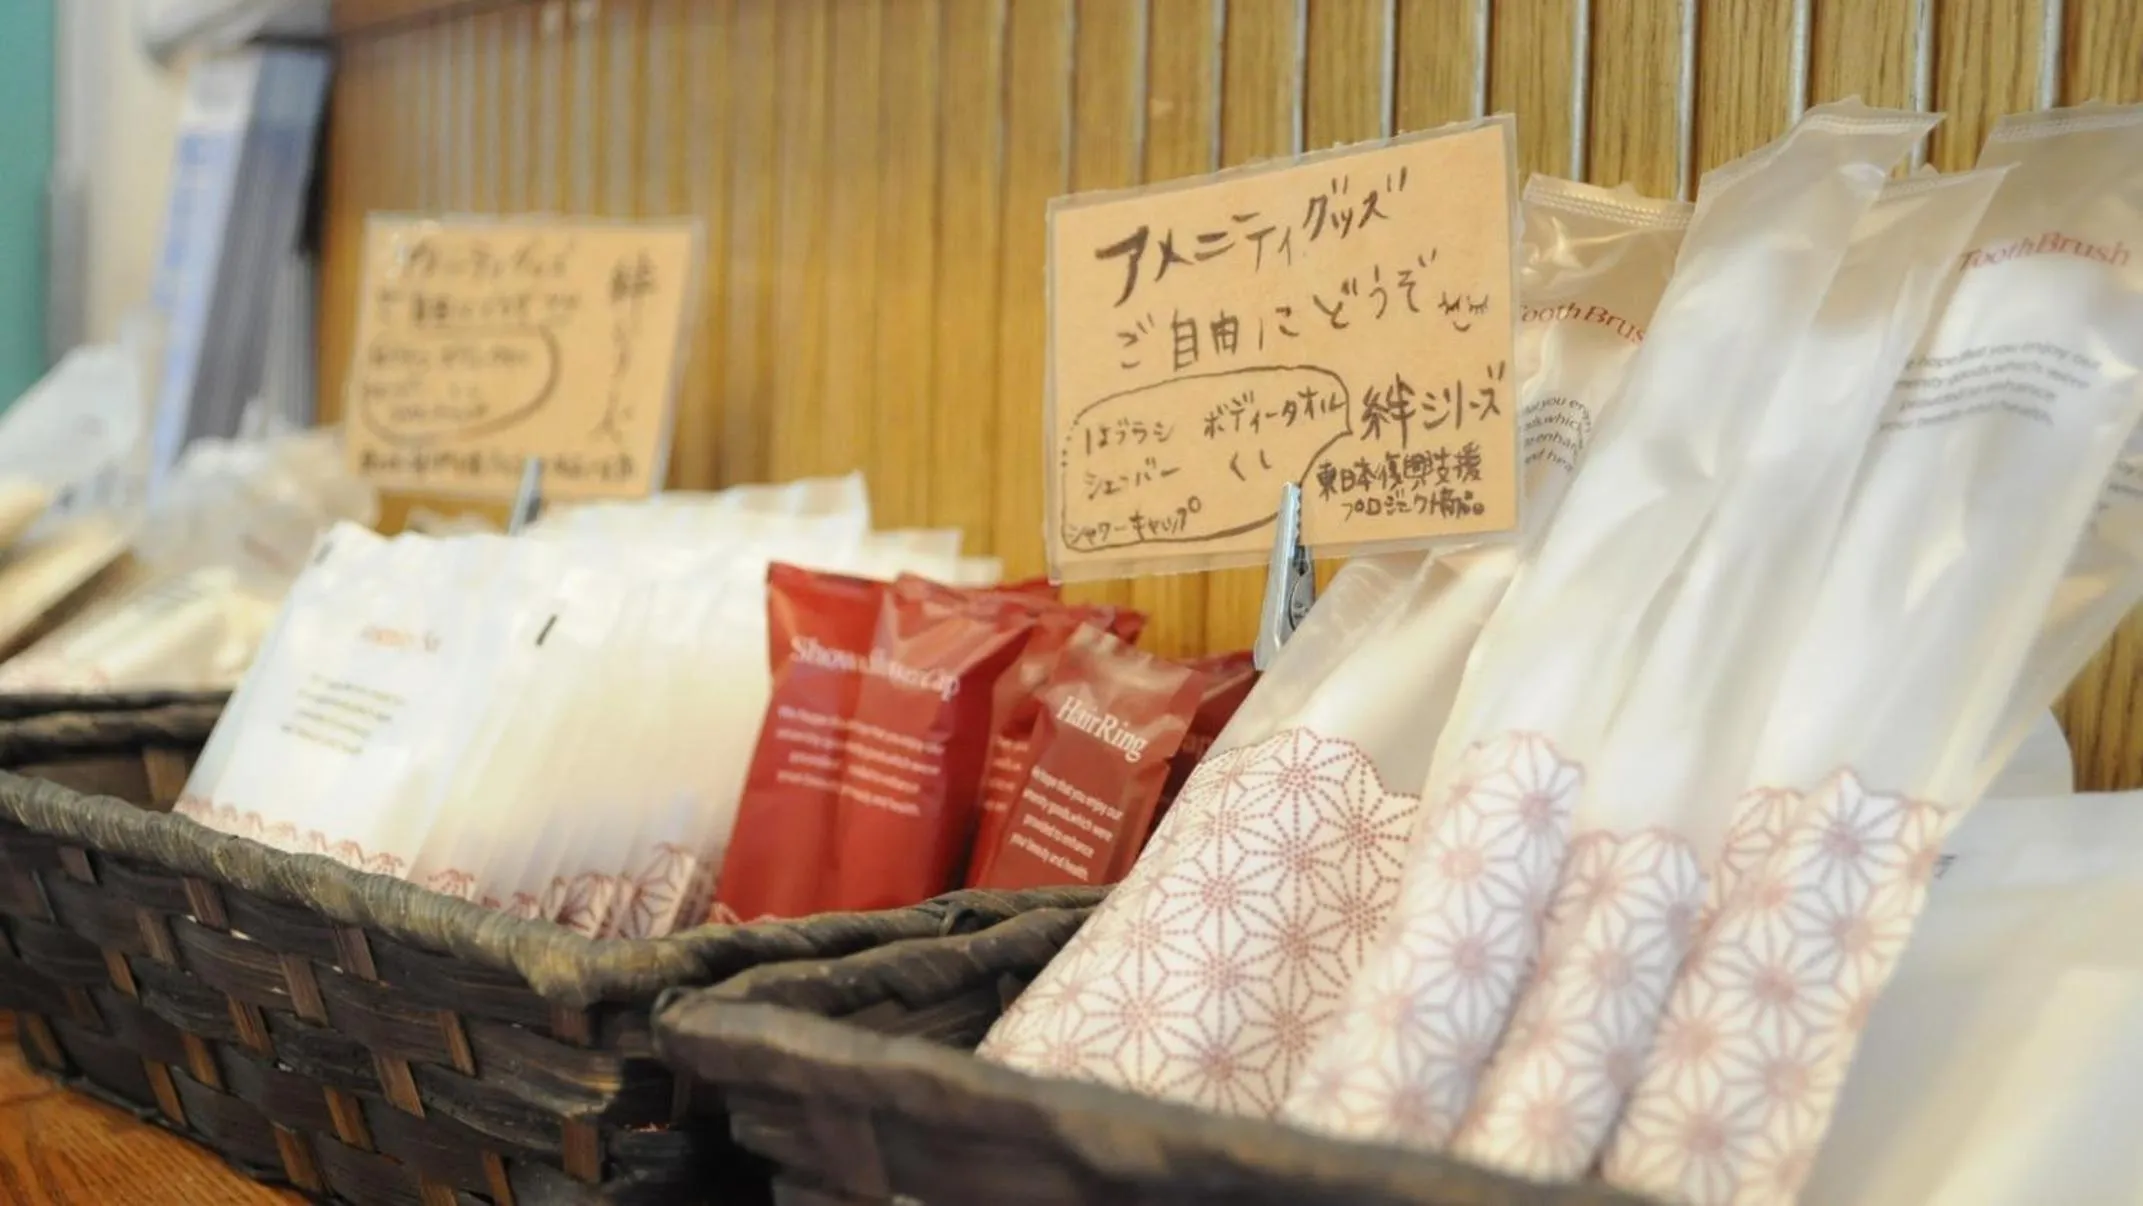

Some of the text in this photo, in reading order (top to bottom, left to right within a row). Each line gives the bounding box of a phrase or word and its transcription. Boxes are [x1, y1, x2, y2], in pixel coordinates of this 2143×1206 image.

[1116, 249, 1438, 372] ご自由にどうぞ
[1521, 302, 1645, 342] oothBrus
[1204, 389, 1345, 438] ボディータオル
[1360, 360, 1505, 449] 絆シリーズ
[1230, 450, 1272, 481] くし
[1056, 696, 1148, 763] HairRing
